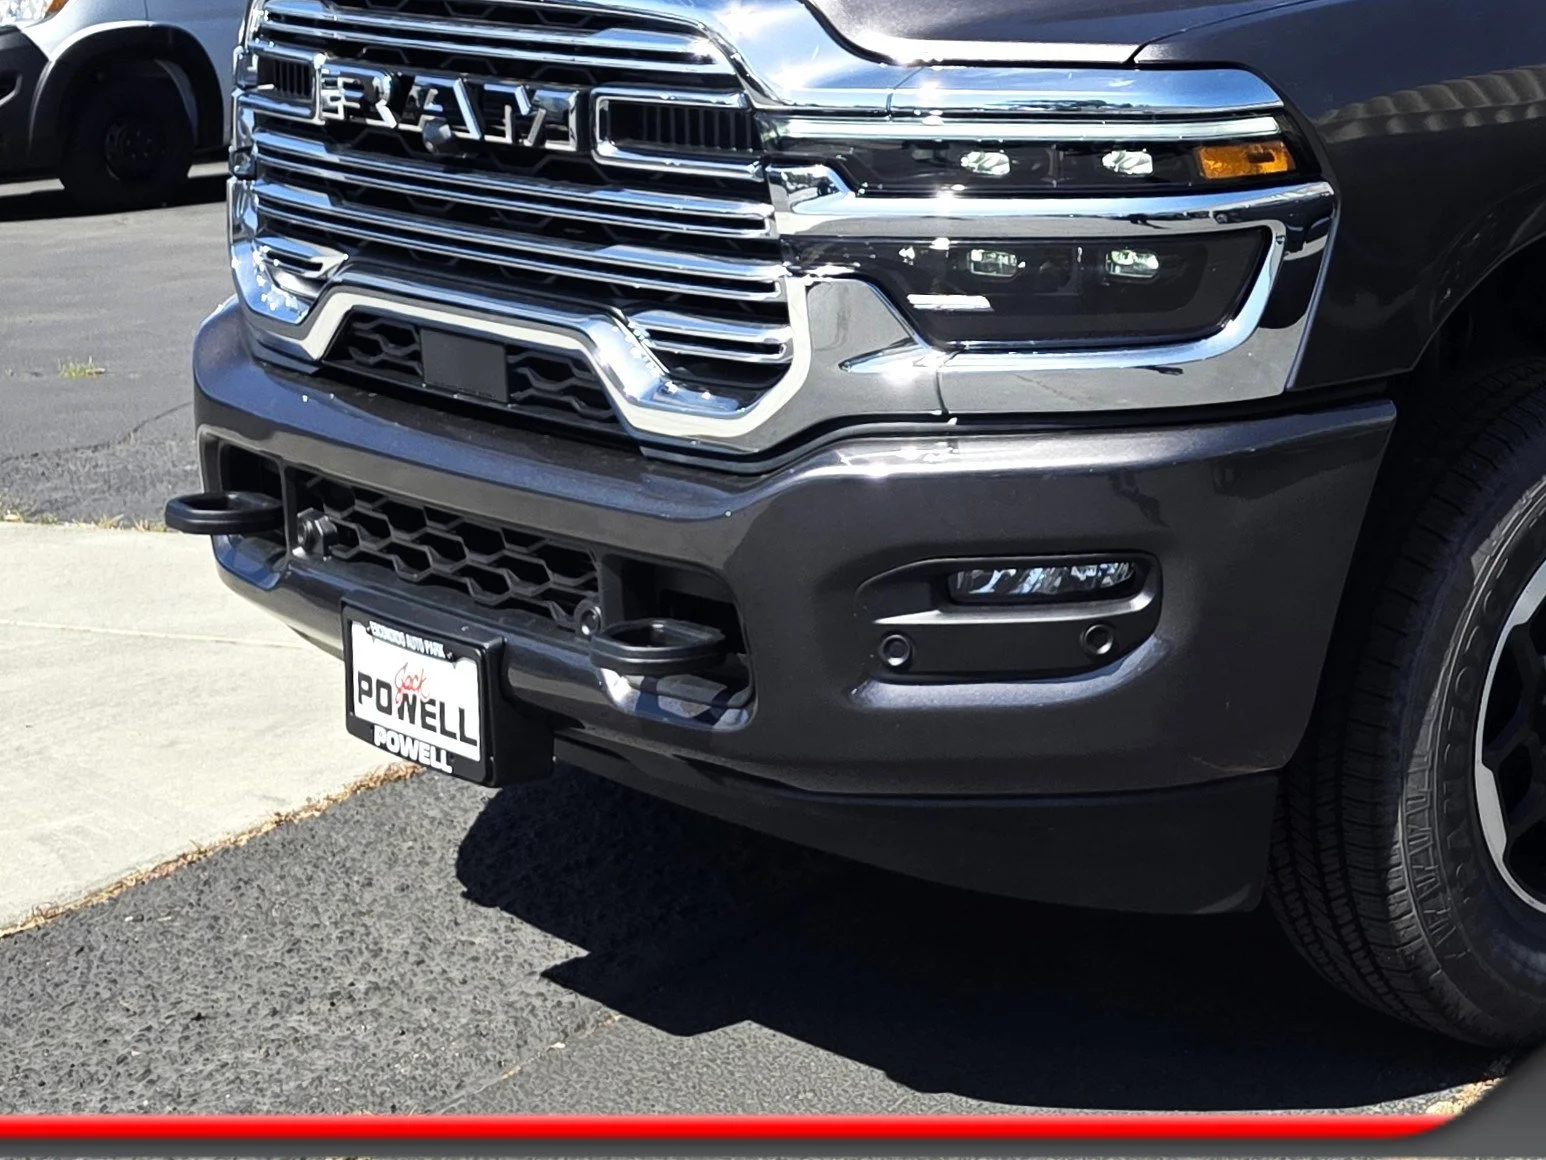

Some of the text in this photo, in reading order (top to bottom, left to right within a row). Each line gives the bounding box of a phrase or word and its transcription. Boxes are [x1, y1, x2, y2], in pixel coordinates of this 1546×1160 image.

[319, 62, 580, 152] RAM
[358, 671, 478, 747] POWELL
[394, 662, 430, 705] Jack
[373, 724, 453, 774] POWELL
